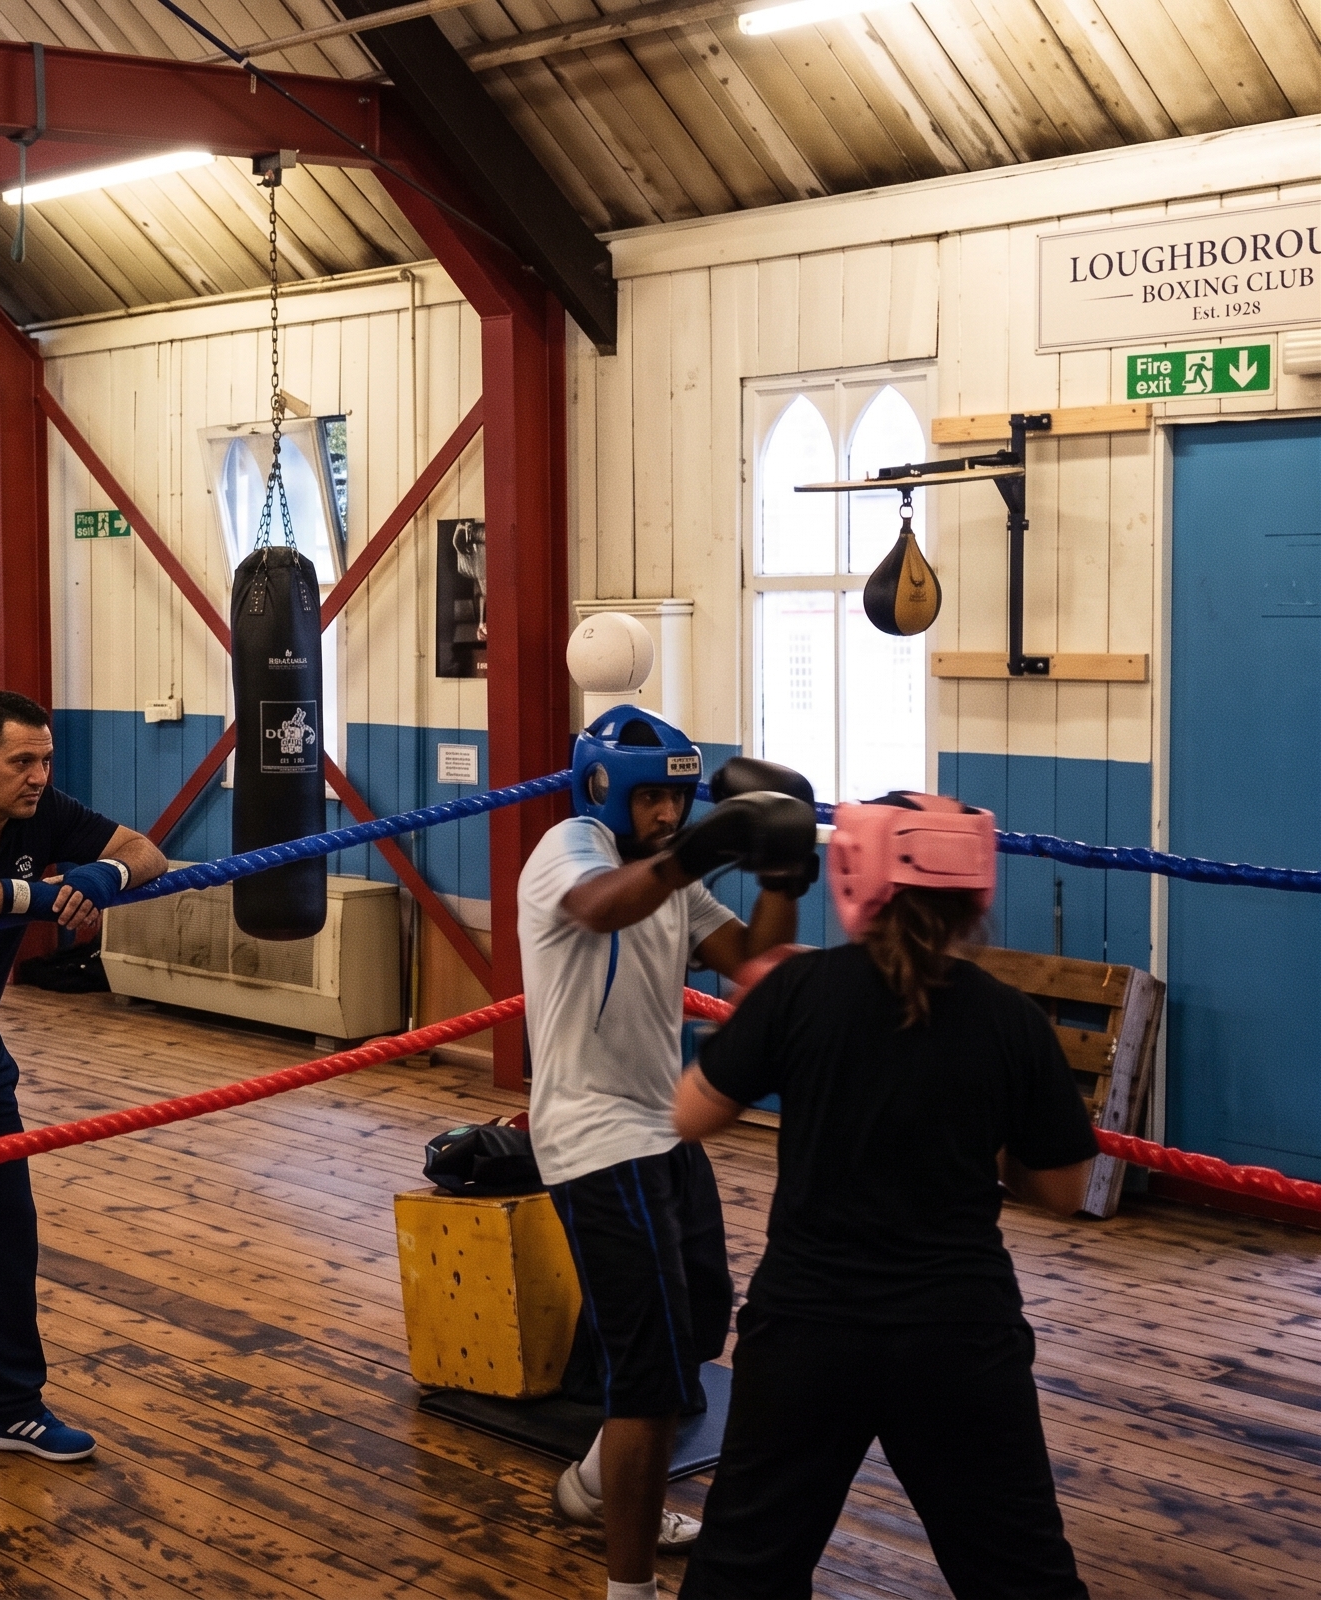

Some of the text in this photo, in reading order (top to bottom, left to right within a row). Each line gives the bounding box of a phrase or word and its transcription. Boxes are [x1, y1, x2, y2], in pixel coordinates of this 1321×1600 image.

[1142, 267, 1314, 303] BOXING CLUB
[1192, 300, 1261, 321] Est. 1928
[1136, 358, 1172, 375] Fire
[1136, 376, 1172, 394] exit
